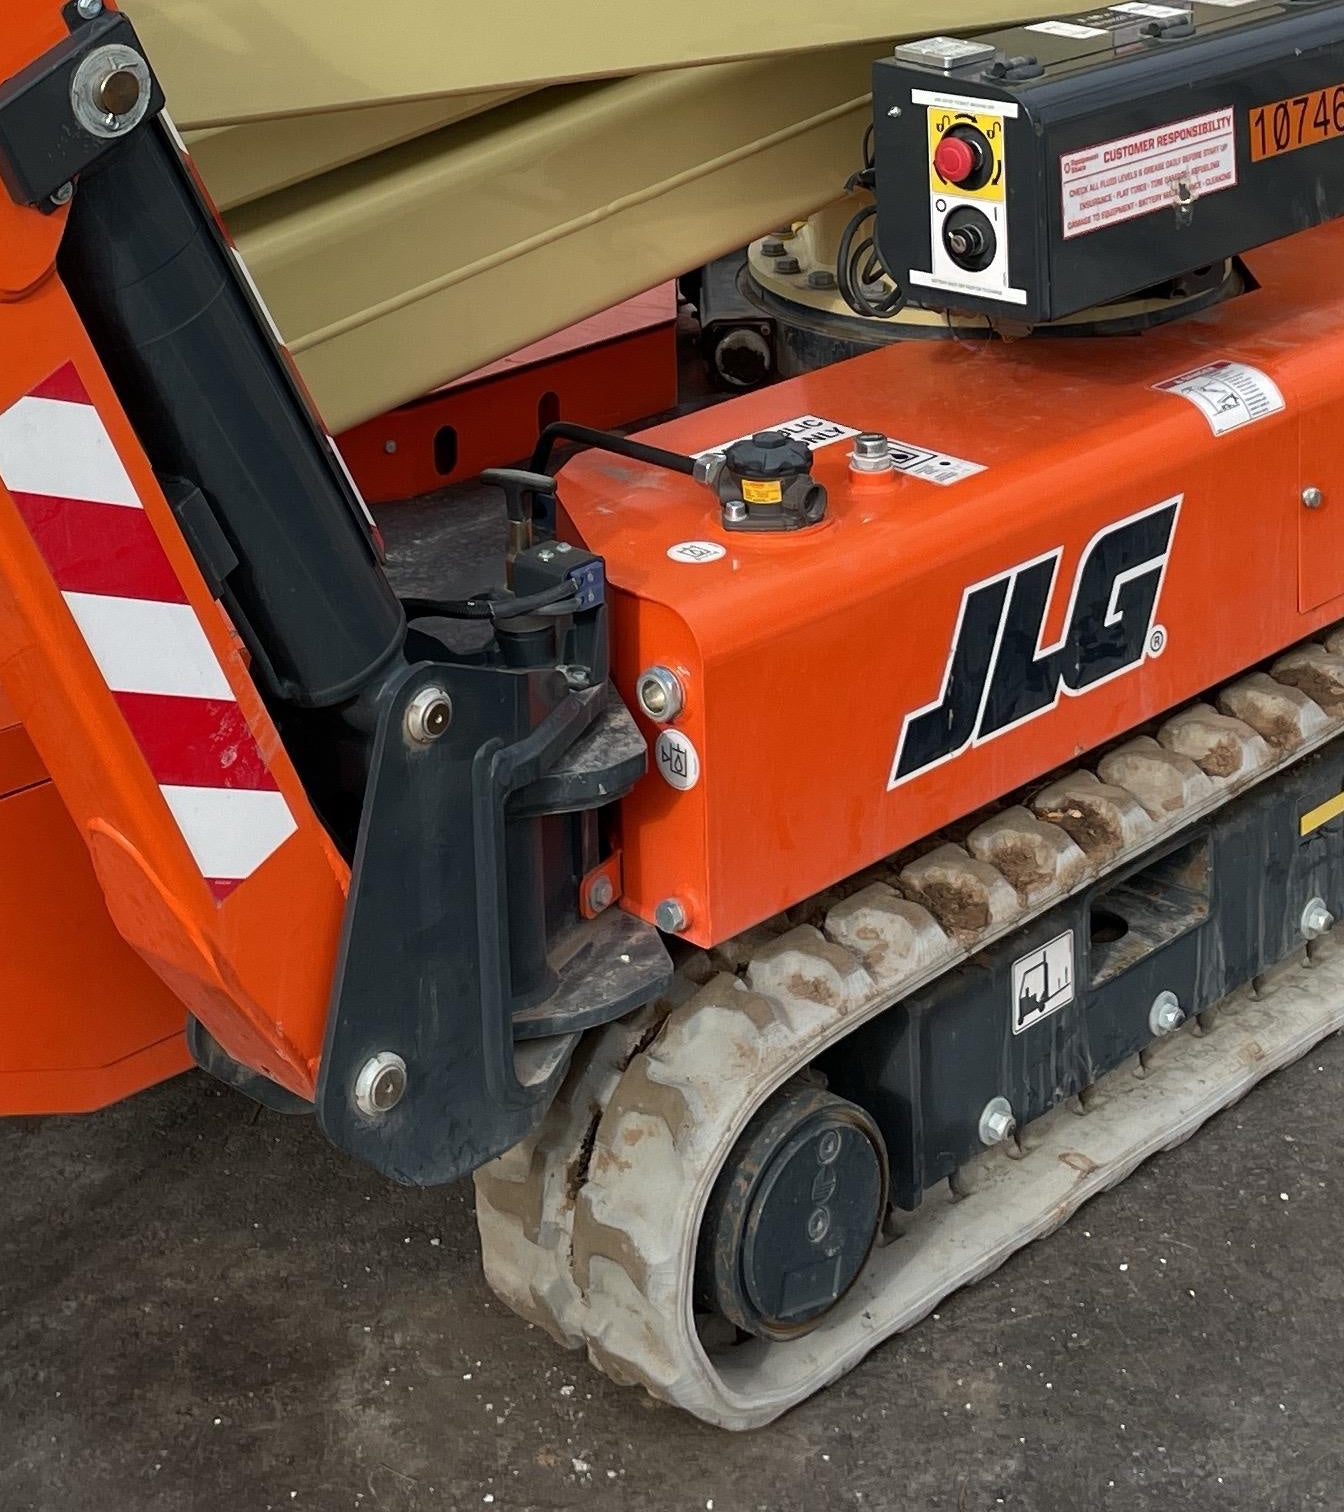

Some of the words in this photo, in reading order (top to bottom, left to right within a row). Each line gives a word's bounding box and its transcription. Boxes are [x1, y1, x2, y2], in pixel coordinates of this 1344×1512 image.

[1103, 137, 1154, 163] CUSTOMER
[1156, 114, 1231, 147] RESPONSIBILITY
[887, 493, 1184, 792] JLG
